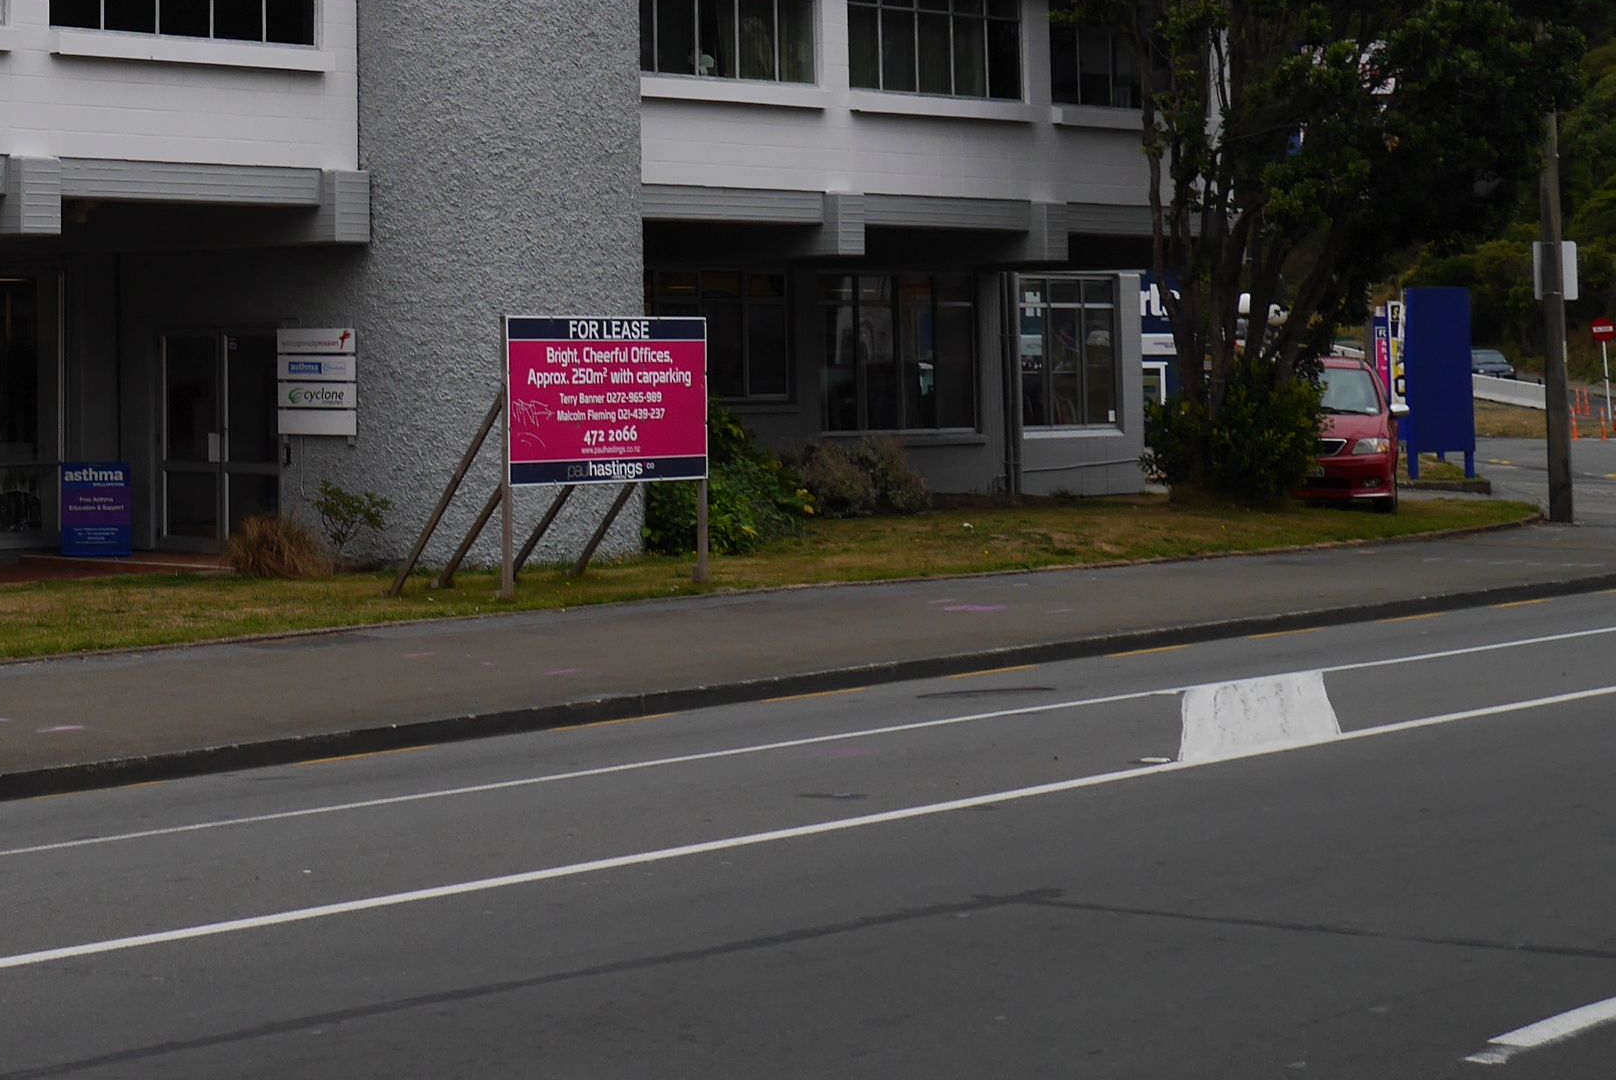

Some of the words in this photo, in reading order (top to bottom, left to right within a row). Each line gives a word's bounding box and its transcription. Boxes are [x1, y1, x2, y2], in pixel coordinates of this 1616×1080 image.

[569, 320, 599, 339] FOR
[603, 320, 650, 339] LEASE
[546, 346, 580, 367] Bright,
[583, 346, 629, 363] Cheerful
[631, 346, 673, 364] Offices,
[528, 368, 570, 388] Approx.
[610, 368, 634, 384] with
[636, 367, 692, 387] carparking
[303, 387, 344, 403] cyclone
[559, 393, 578, 406] Terry
[579, 392, 605, 404] Banner
[557, 410, 586, 421] Malcolm
[587, 409, 616, 423] Fleming
[583, 430, 605, 446] 472
[608, 425, 638, 442] 2066
[64, 467, 124, 482] asthma
